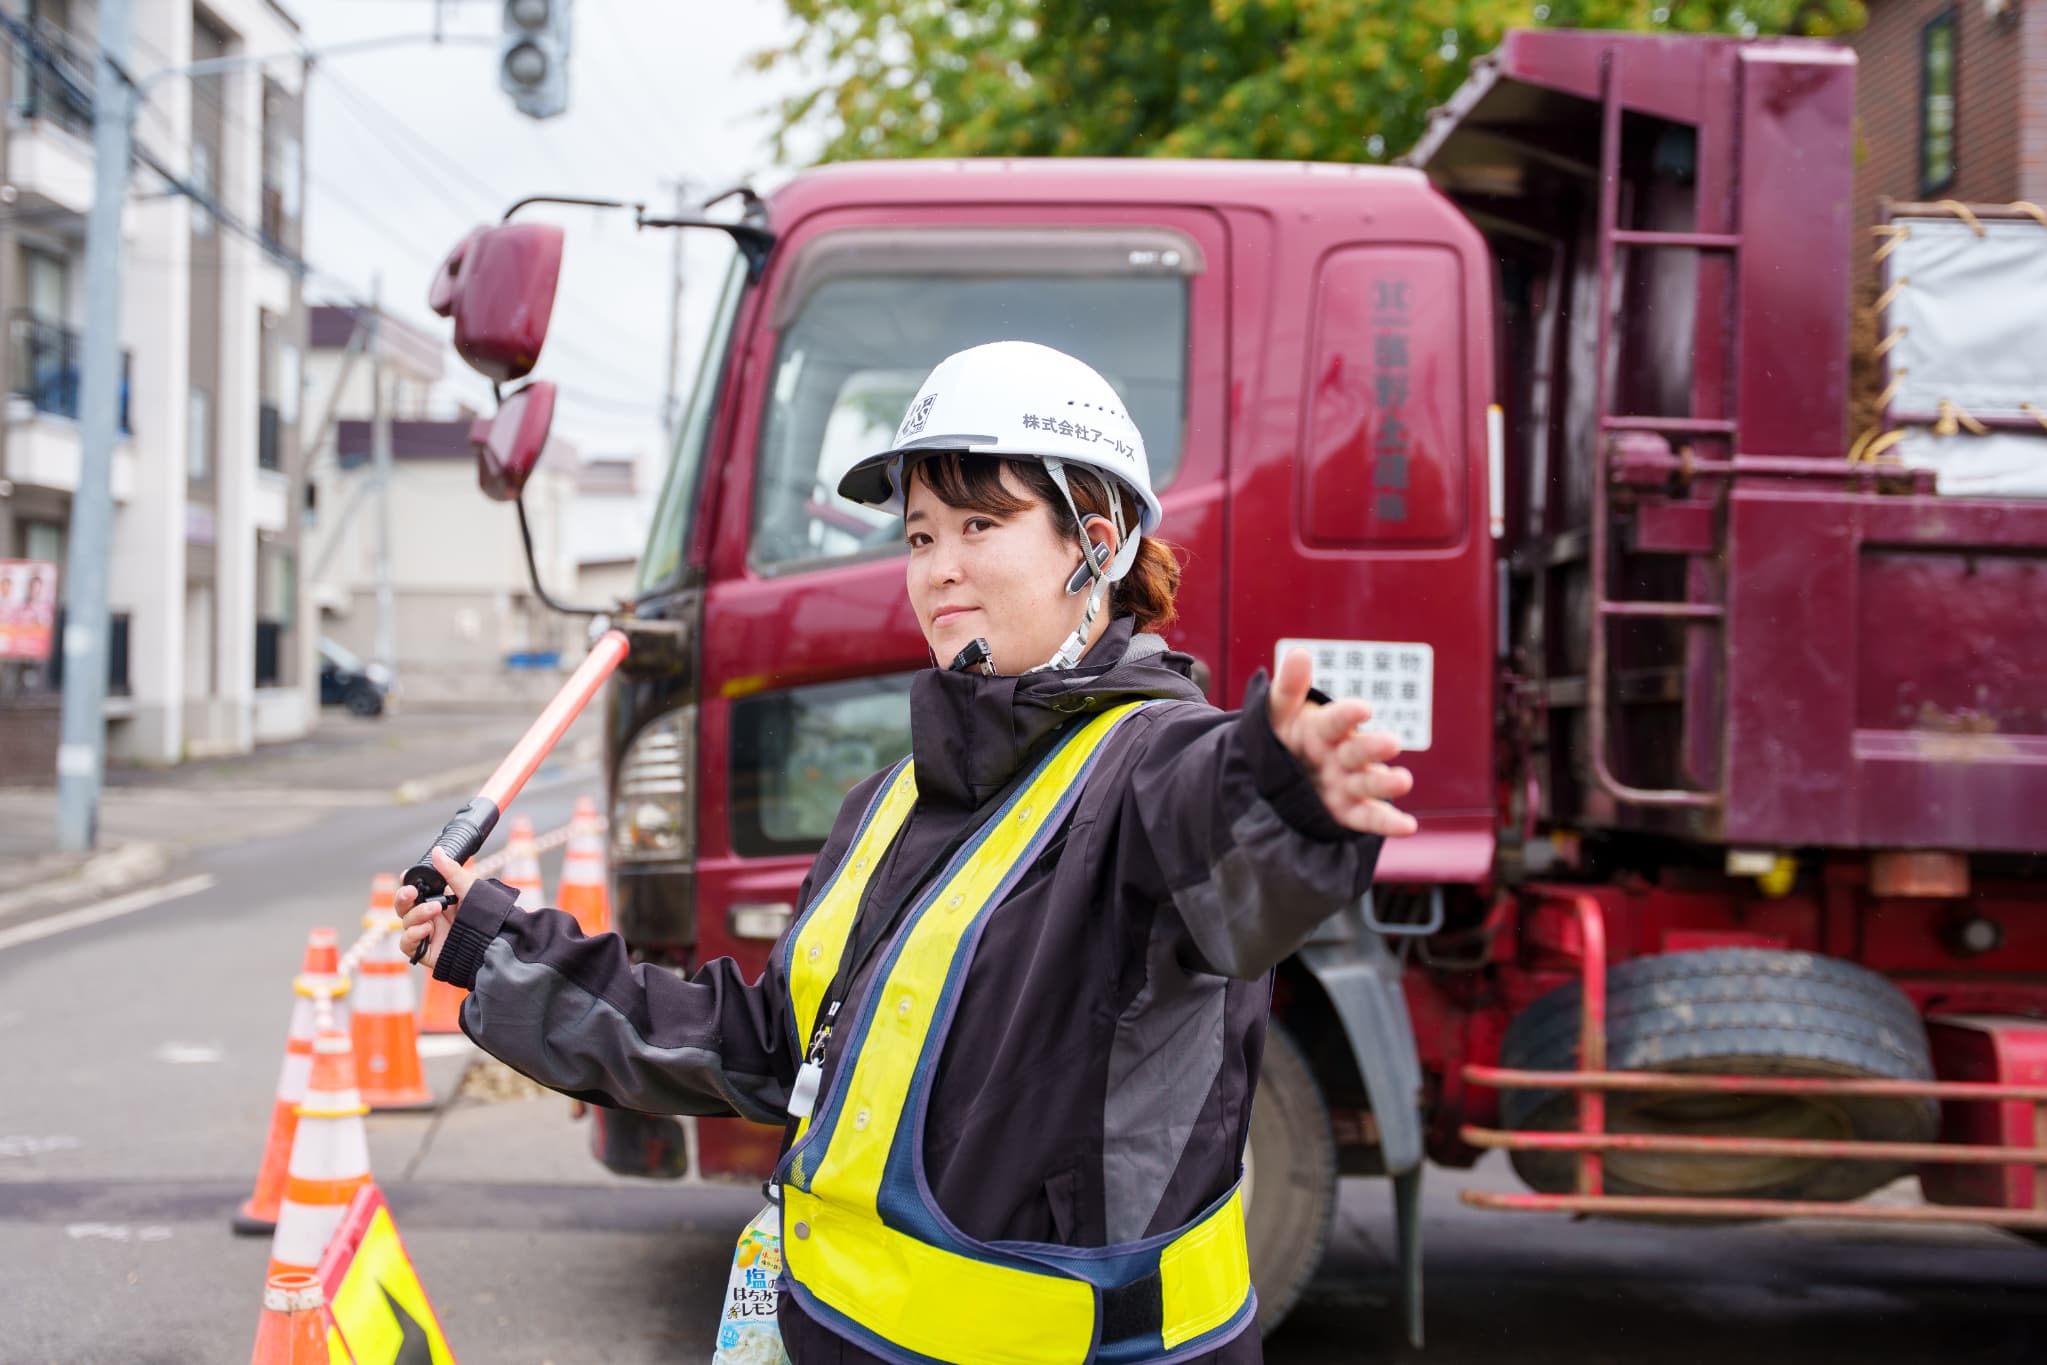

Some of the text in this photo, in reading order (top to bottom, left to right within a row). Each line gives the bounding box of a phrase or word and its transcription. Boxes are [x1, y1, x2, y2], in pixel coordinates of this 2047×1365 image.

[1319, 649, 1421, 671] 業廃棄物
[1318, 679, 1417, 700] 運搬車
[742, 1303, 778, 1316] レモン
